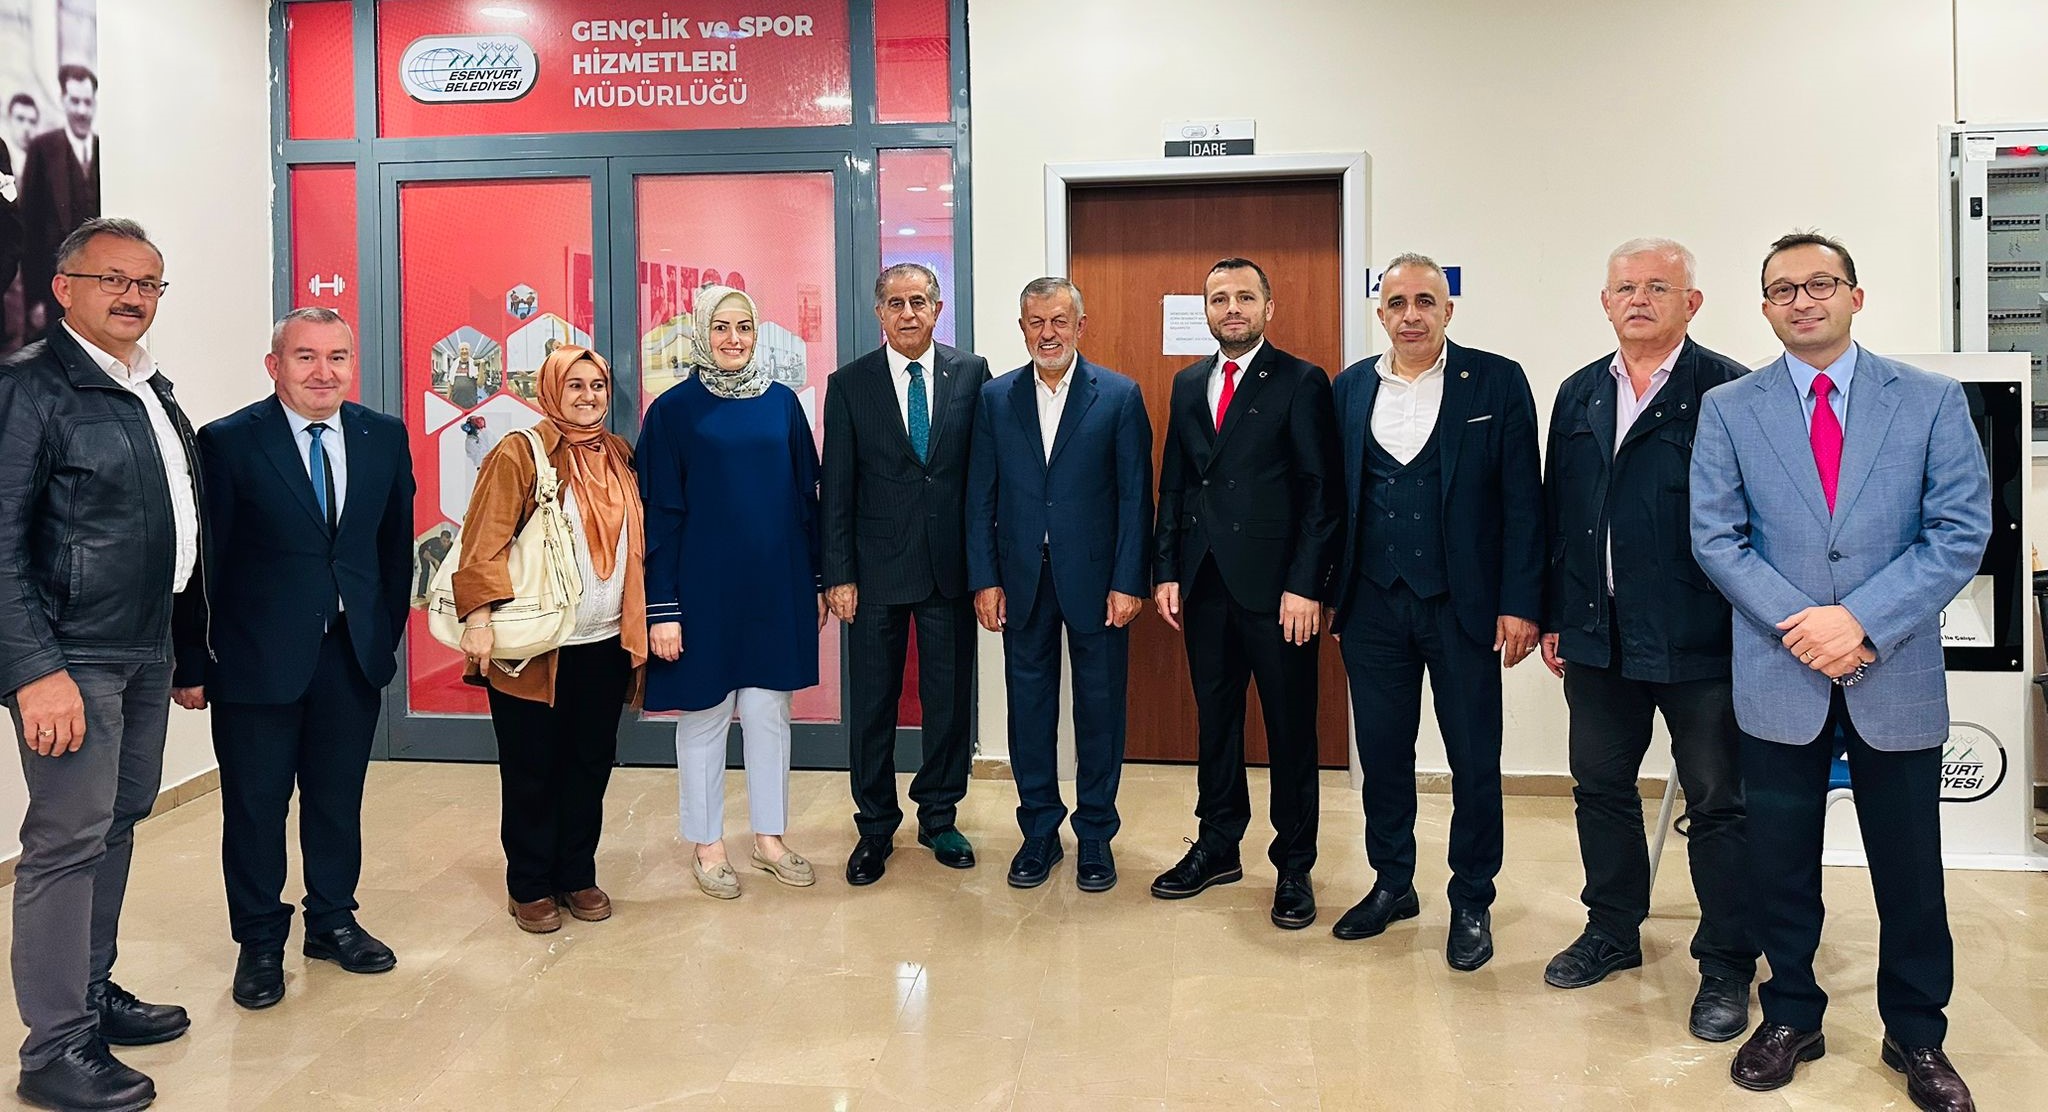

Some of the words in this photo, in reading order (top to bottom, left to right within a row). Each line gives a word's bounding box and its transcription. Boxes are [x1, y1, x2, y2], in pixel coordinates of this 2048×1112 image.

[571, 11, 691, 47] GENÇLİK
[698, 21, 730, 39] ve
[738, 15, 814, 39] SPOR
[572, 44, 737, 75] HİZMETLERİ
[444, 78, 523, 92] BELEDİYESİ
[448, 69, 522, 81] ESENYURT
[573, 77, 747, 108] MÜDÜRLÜĞÜ
[1189, 140, 1227, 156] İDARE
